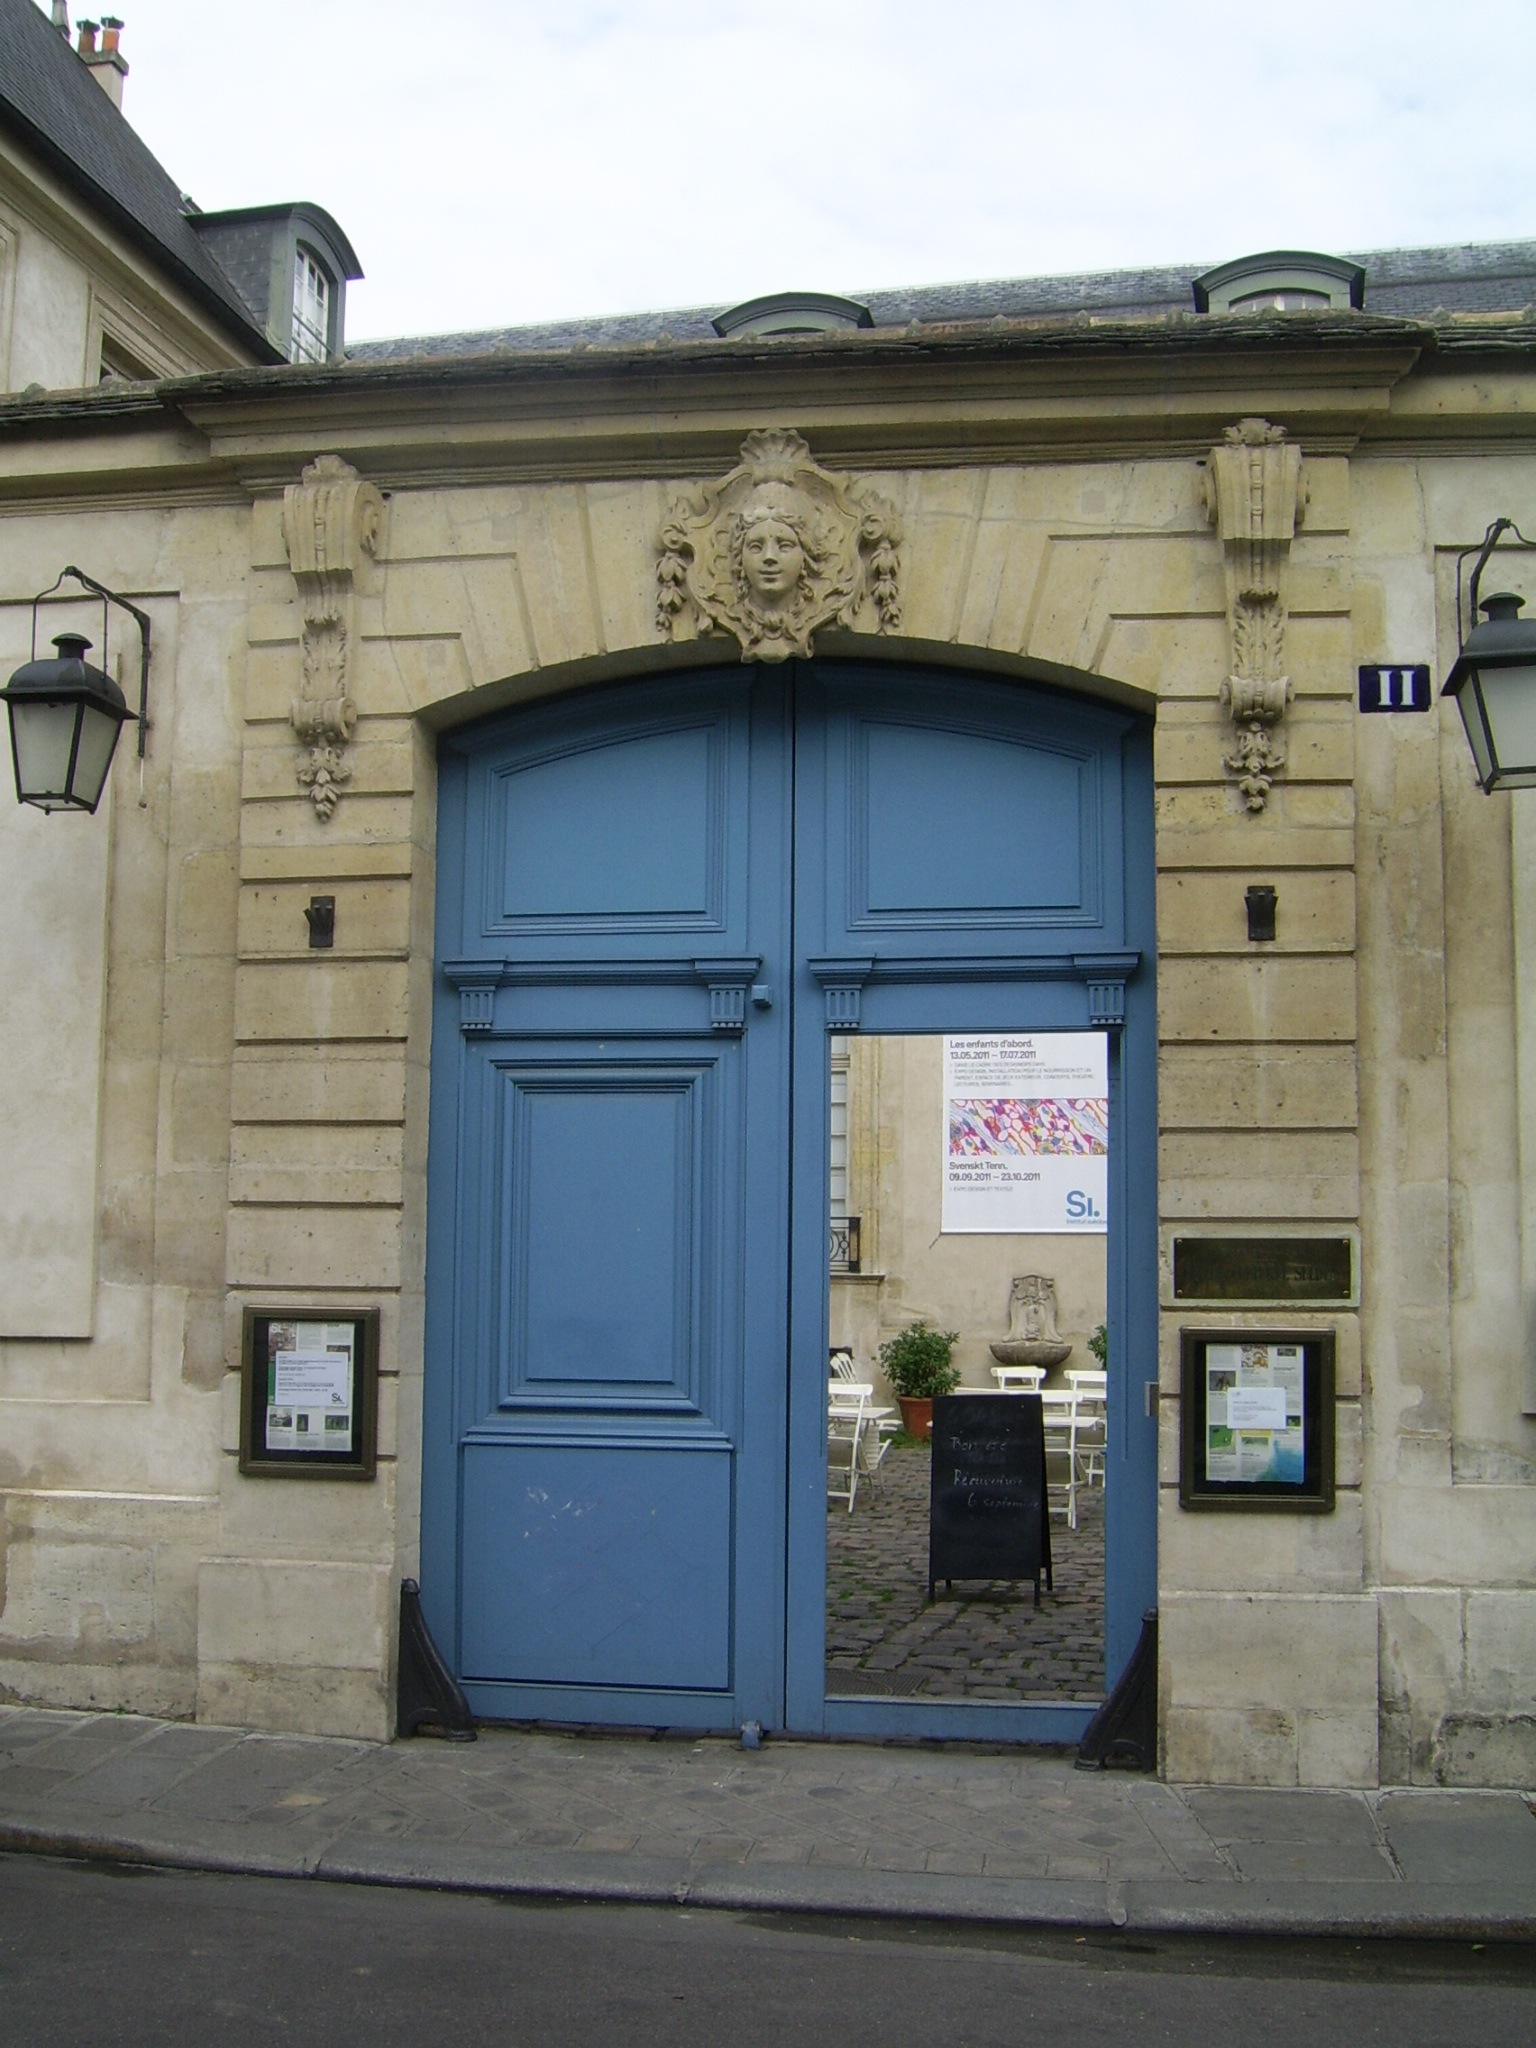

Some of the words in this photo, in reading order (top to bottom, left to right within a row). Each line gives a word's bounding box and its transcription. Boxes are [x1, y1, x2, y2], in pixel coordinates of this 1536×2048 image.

[1377, 670, 1415, 706] 11
[949, 1040, 965, 1049] Les
[966, 1039, 999, 1048] enfants
[1000, 1039, 1034, 1048] d'abord.
[949, 1051, 990, 1060] 13.05.2011
[1000, 1050, 1037, 1059] 17.07.2011
[949, 1161, 983, 1170] Svenskt
[984, 1161, 1008, 1170] Tenn.
[949, 1172, 992, 1181] 09.09.2011
[1000, 1172, 1041, 1181] 23.10.2011
[949, 1436, 977, 1451] Bon
